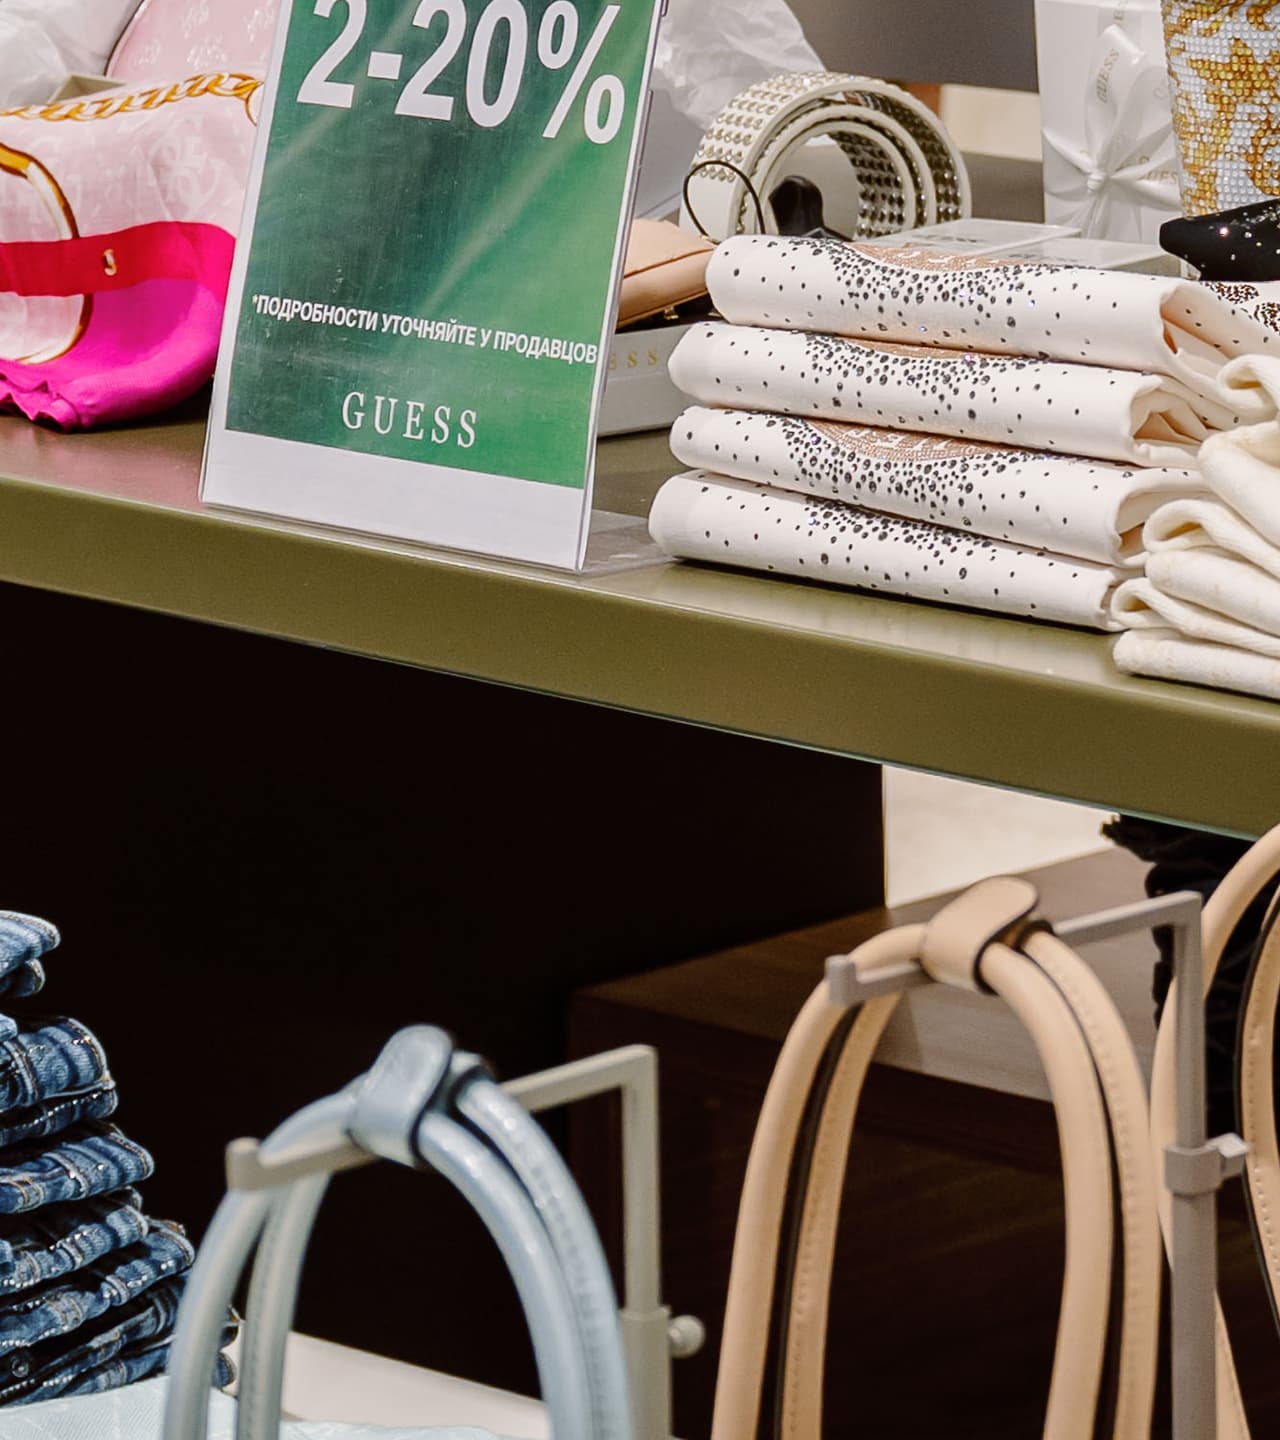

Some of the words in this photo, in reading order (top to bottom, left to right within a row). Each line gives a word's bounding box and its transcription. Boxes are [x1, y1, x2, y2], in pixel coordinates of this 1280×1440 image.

[381, 313, 476, 347] УТОЧНЯЙТЕ
[479, 328, 492, 349] У
[493, 330, 598, 365] ПРОДАВЦОВ
[342, 391, 477, 449] GUESS
